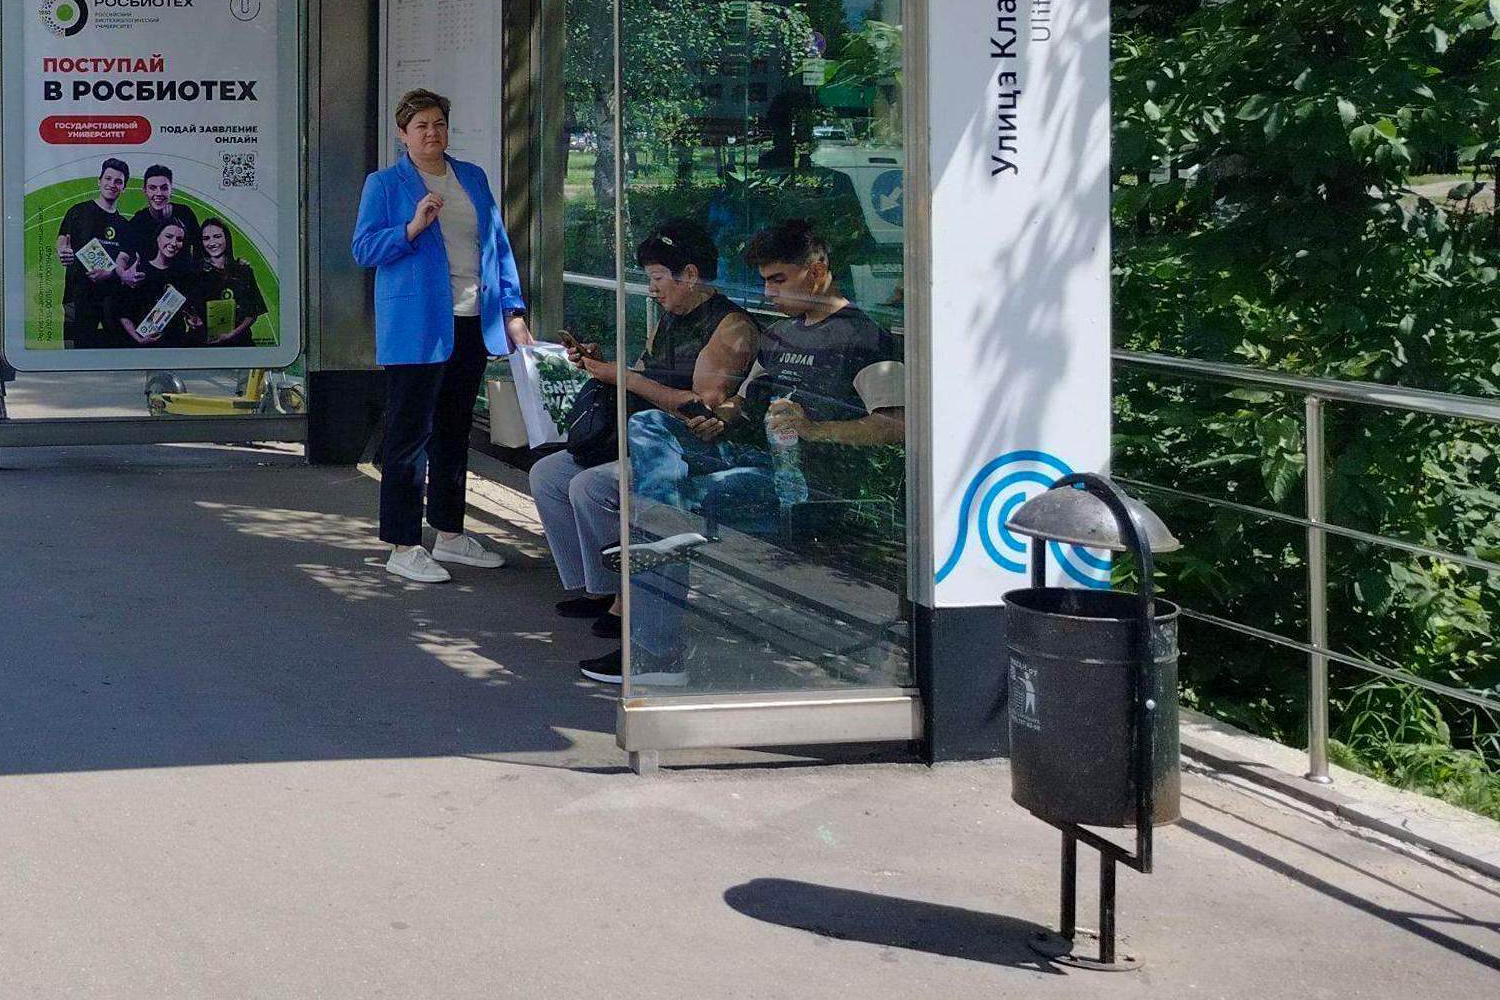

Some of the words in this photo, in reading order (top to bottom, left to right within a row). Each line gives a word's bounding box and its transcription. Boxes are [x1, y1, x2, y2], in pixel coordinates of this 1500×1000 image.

[43, 54, 164, 73] ПОСТУПАЙ
[44, 80, 63, 101] В
[73, 80, 258, 101] РОСБИОТЕХ
[54, 121, 138, 129] ГОСУДАРСТВЕННЫЙ
[160, 124, 196, 134] ПОДАЙ
[199, 125, 258, 133] ЗАЯВЛЕНИЕ
[990, 71, 1021, 176] Улица
[215, 134, 258, 144] ОНЛАЙН
[780, 352, 815, 366] JORDAN
[541, 380, 582, 394] GREE
